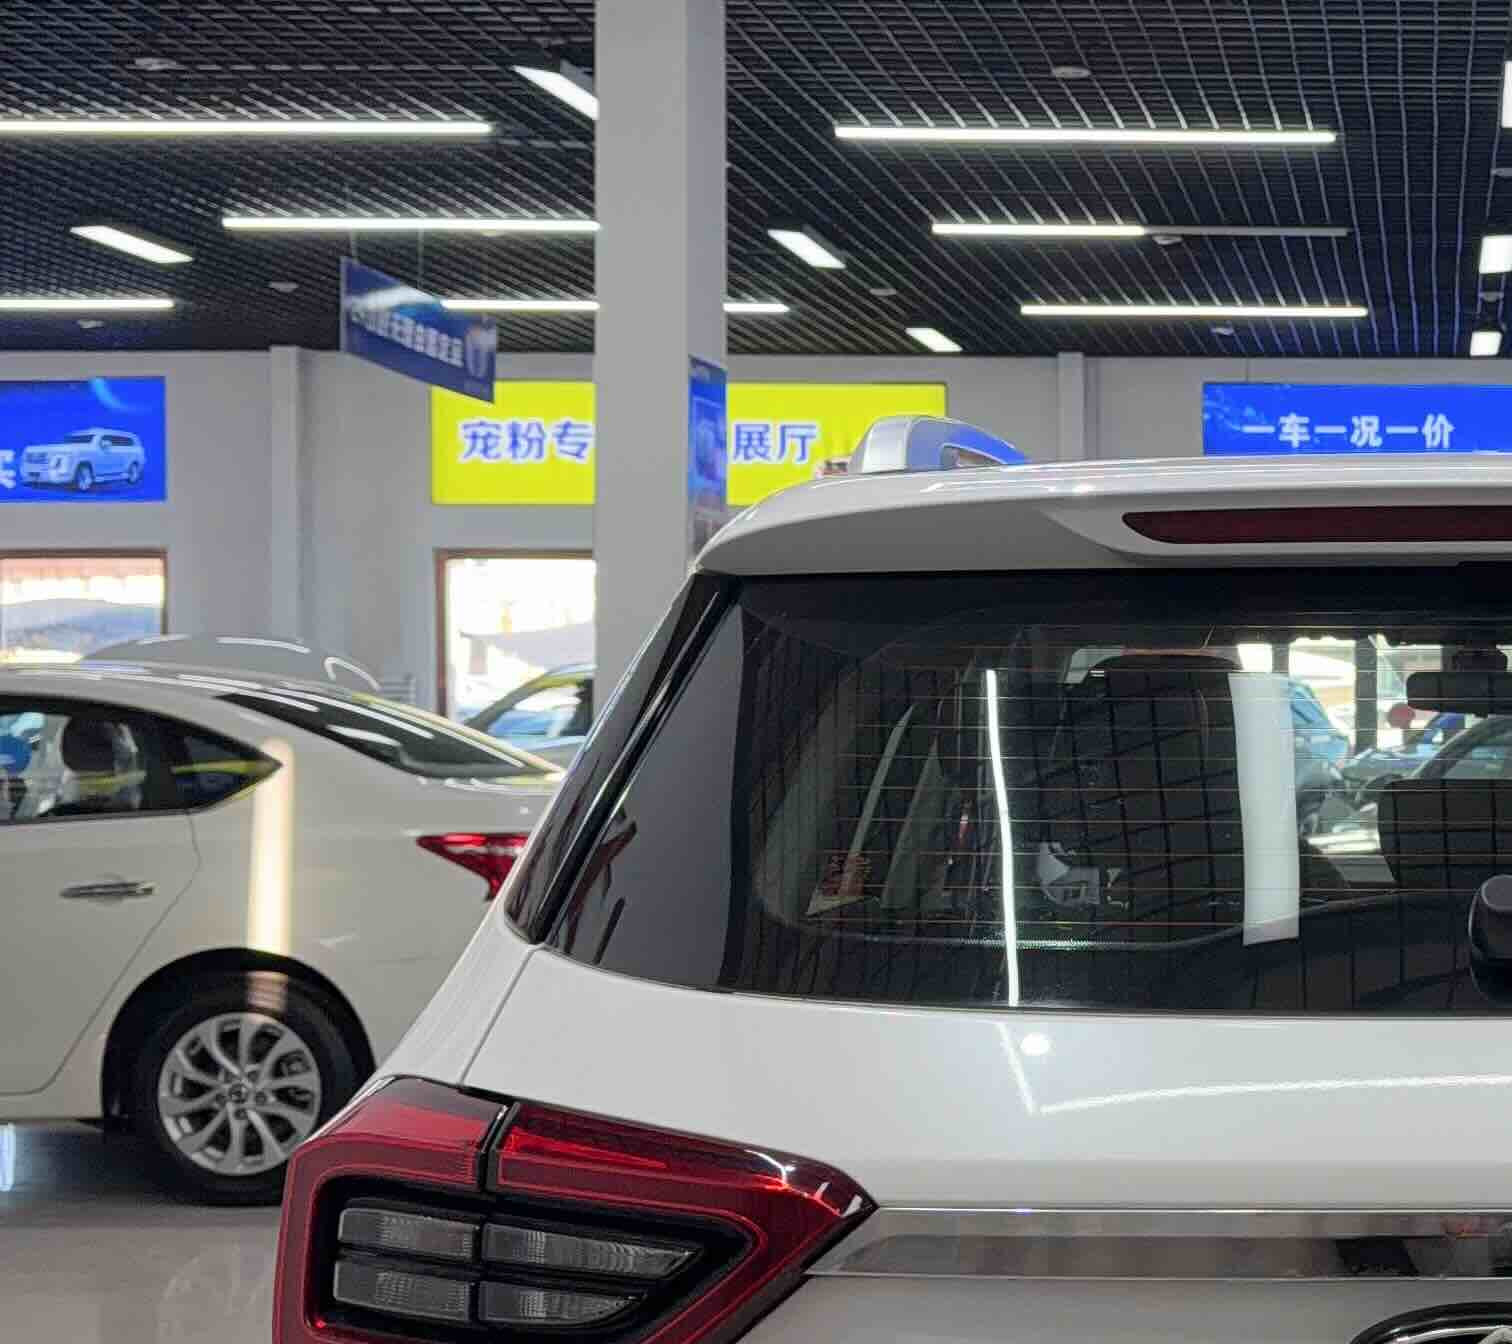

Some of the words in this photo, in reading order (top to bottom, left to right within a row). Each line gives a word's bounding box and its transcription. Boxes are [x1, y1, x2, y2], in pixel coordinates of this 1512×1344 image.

[460, 419, 594, 461] 宠粉专
[731, 422, 818, 462] 展厅
[1241, 412, 1455, 449] 一车一况一价
